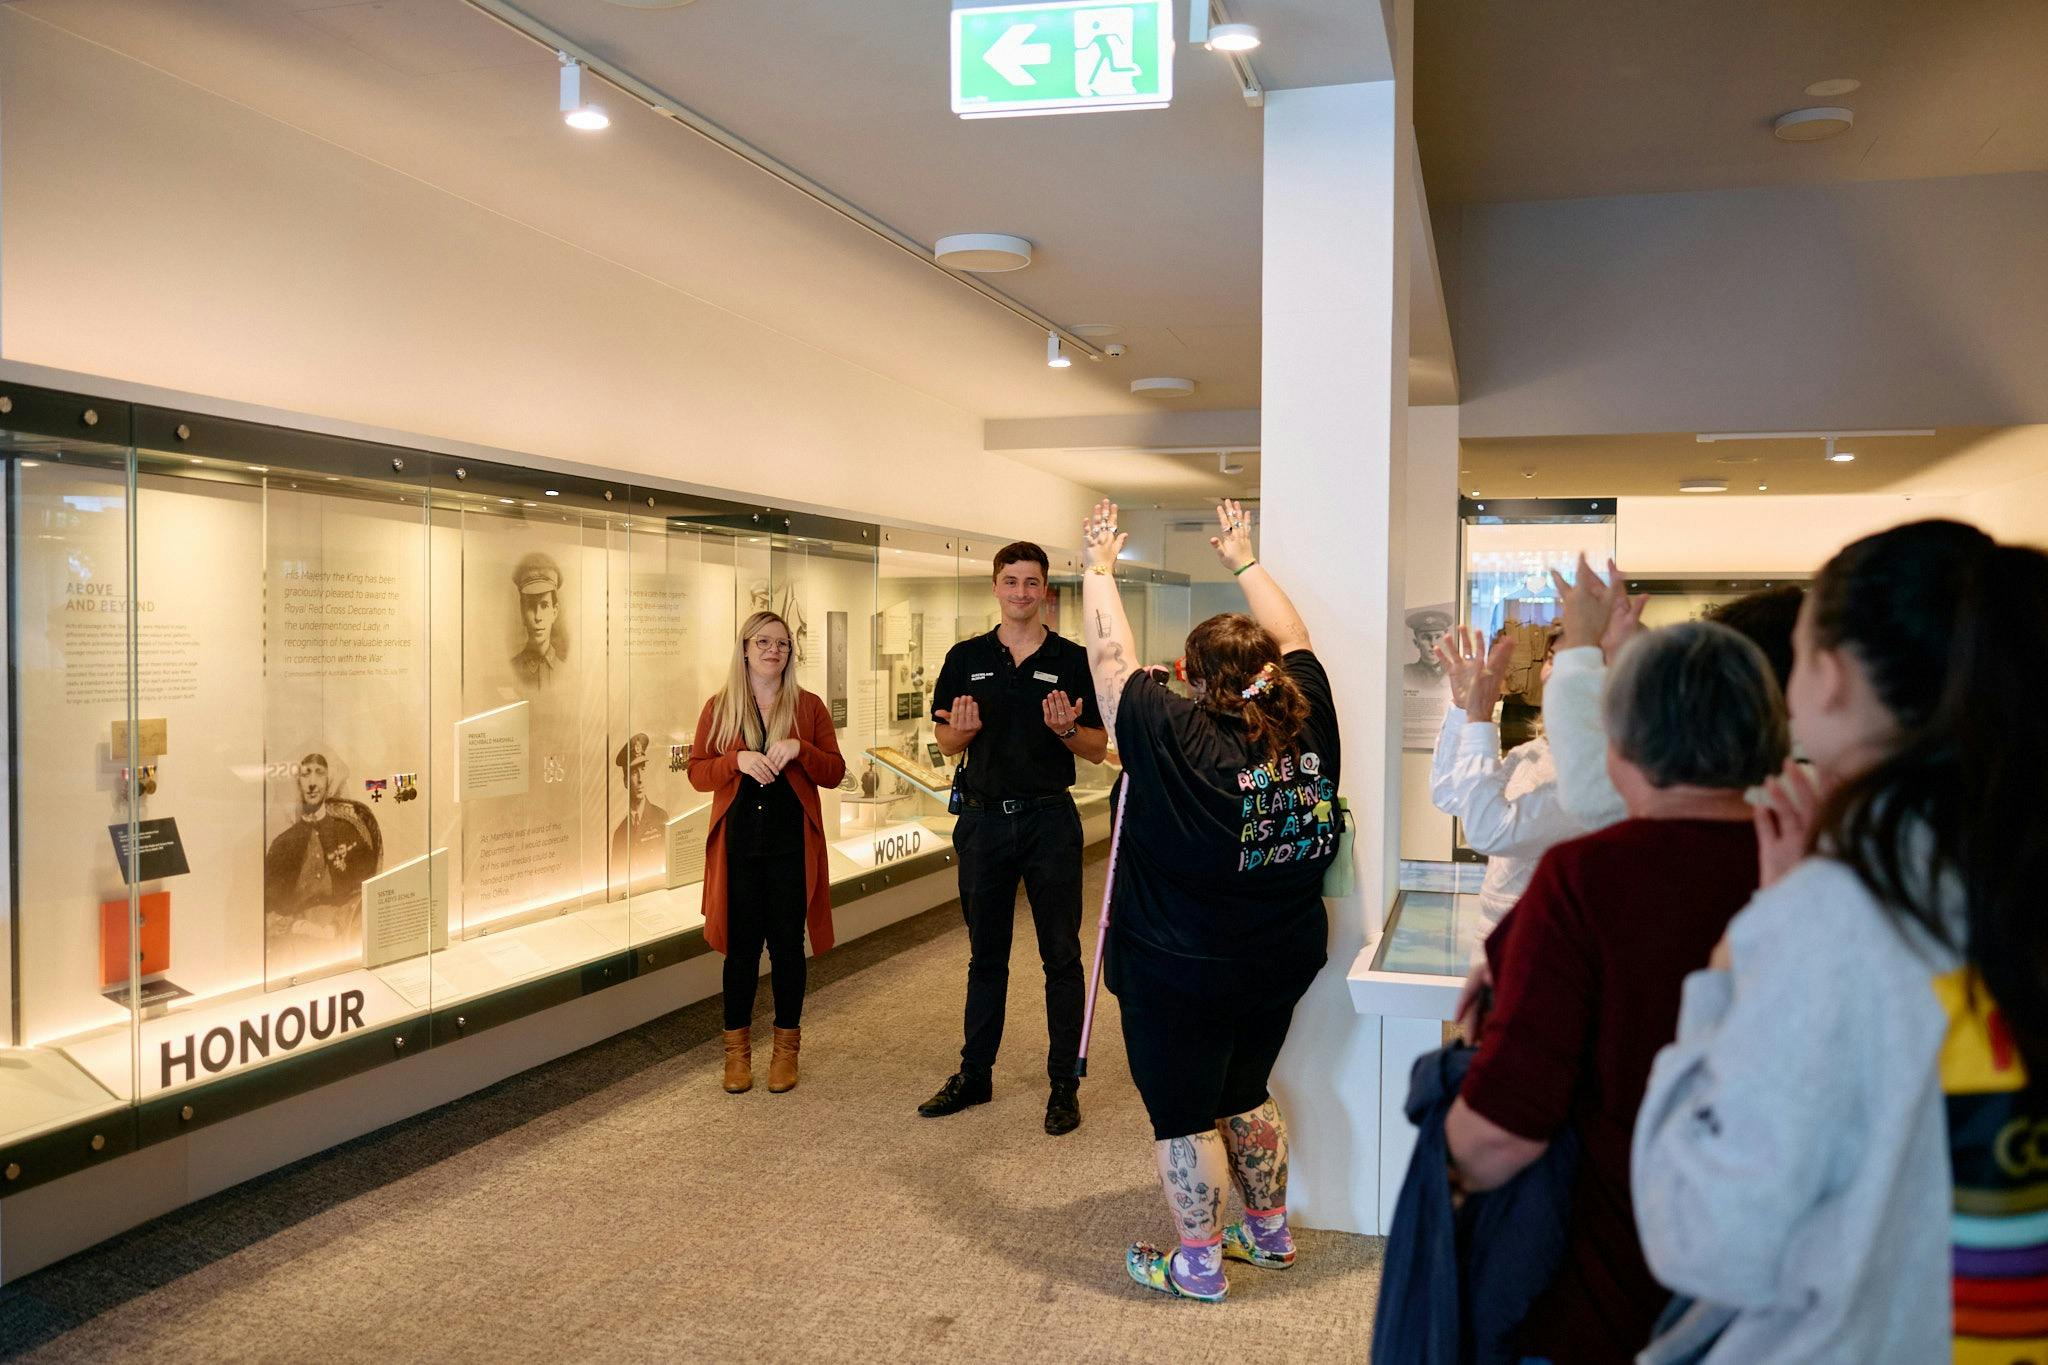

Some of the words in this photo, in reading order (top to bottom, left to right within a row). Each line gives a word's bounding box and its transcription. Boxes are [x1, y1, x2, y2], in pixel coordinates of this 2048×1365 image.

[333, 572, 344, 581] the
[347, 573, 363, 585] King
[65, 599, 97, 611] AND
[284, 603, 306, 616] Royal
[309, 603, 323, 614] Red
[326, 604, 346, 615] Cross
[348, 605, 386, 616] Decoration
[284, 638, 328, 649] recognition
[339, 637, 352, 647] her
[384, 638, 412, 648] services
[338, 654, 353, 663] with
[355, 654, 366, 663] the
[1237, 753, 1295, 791] ROLE
[1242, 778, 1334, 818] PLAYING
[1241, 819, 1276, 843] AS
[1280, 812, 1301, 838] A
[873, 831, 920, 865] WORLD
[161, 989, 365, 1089] HONOUR
